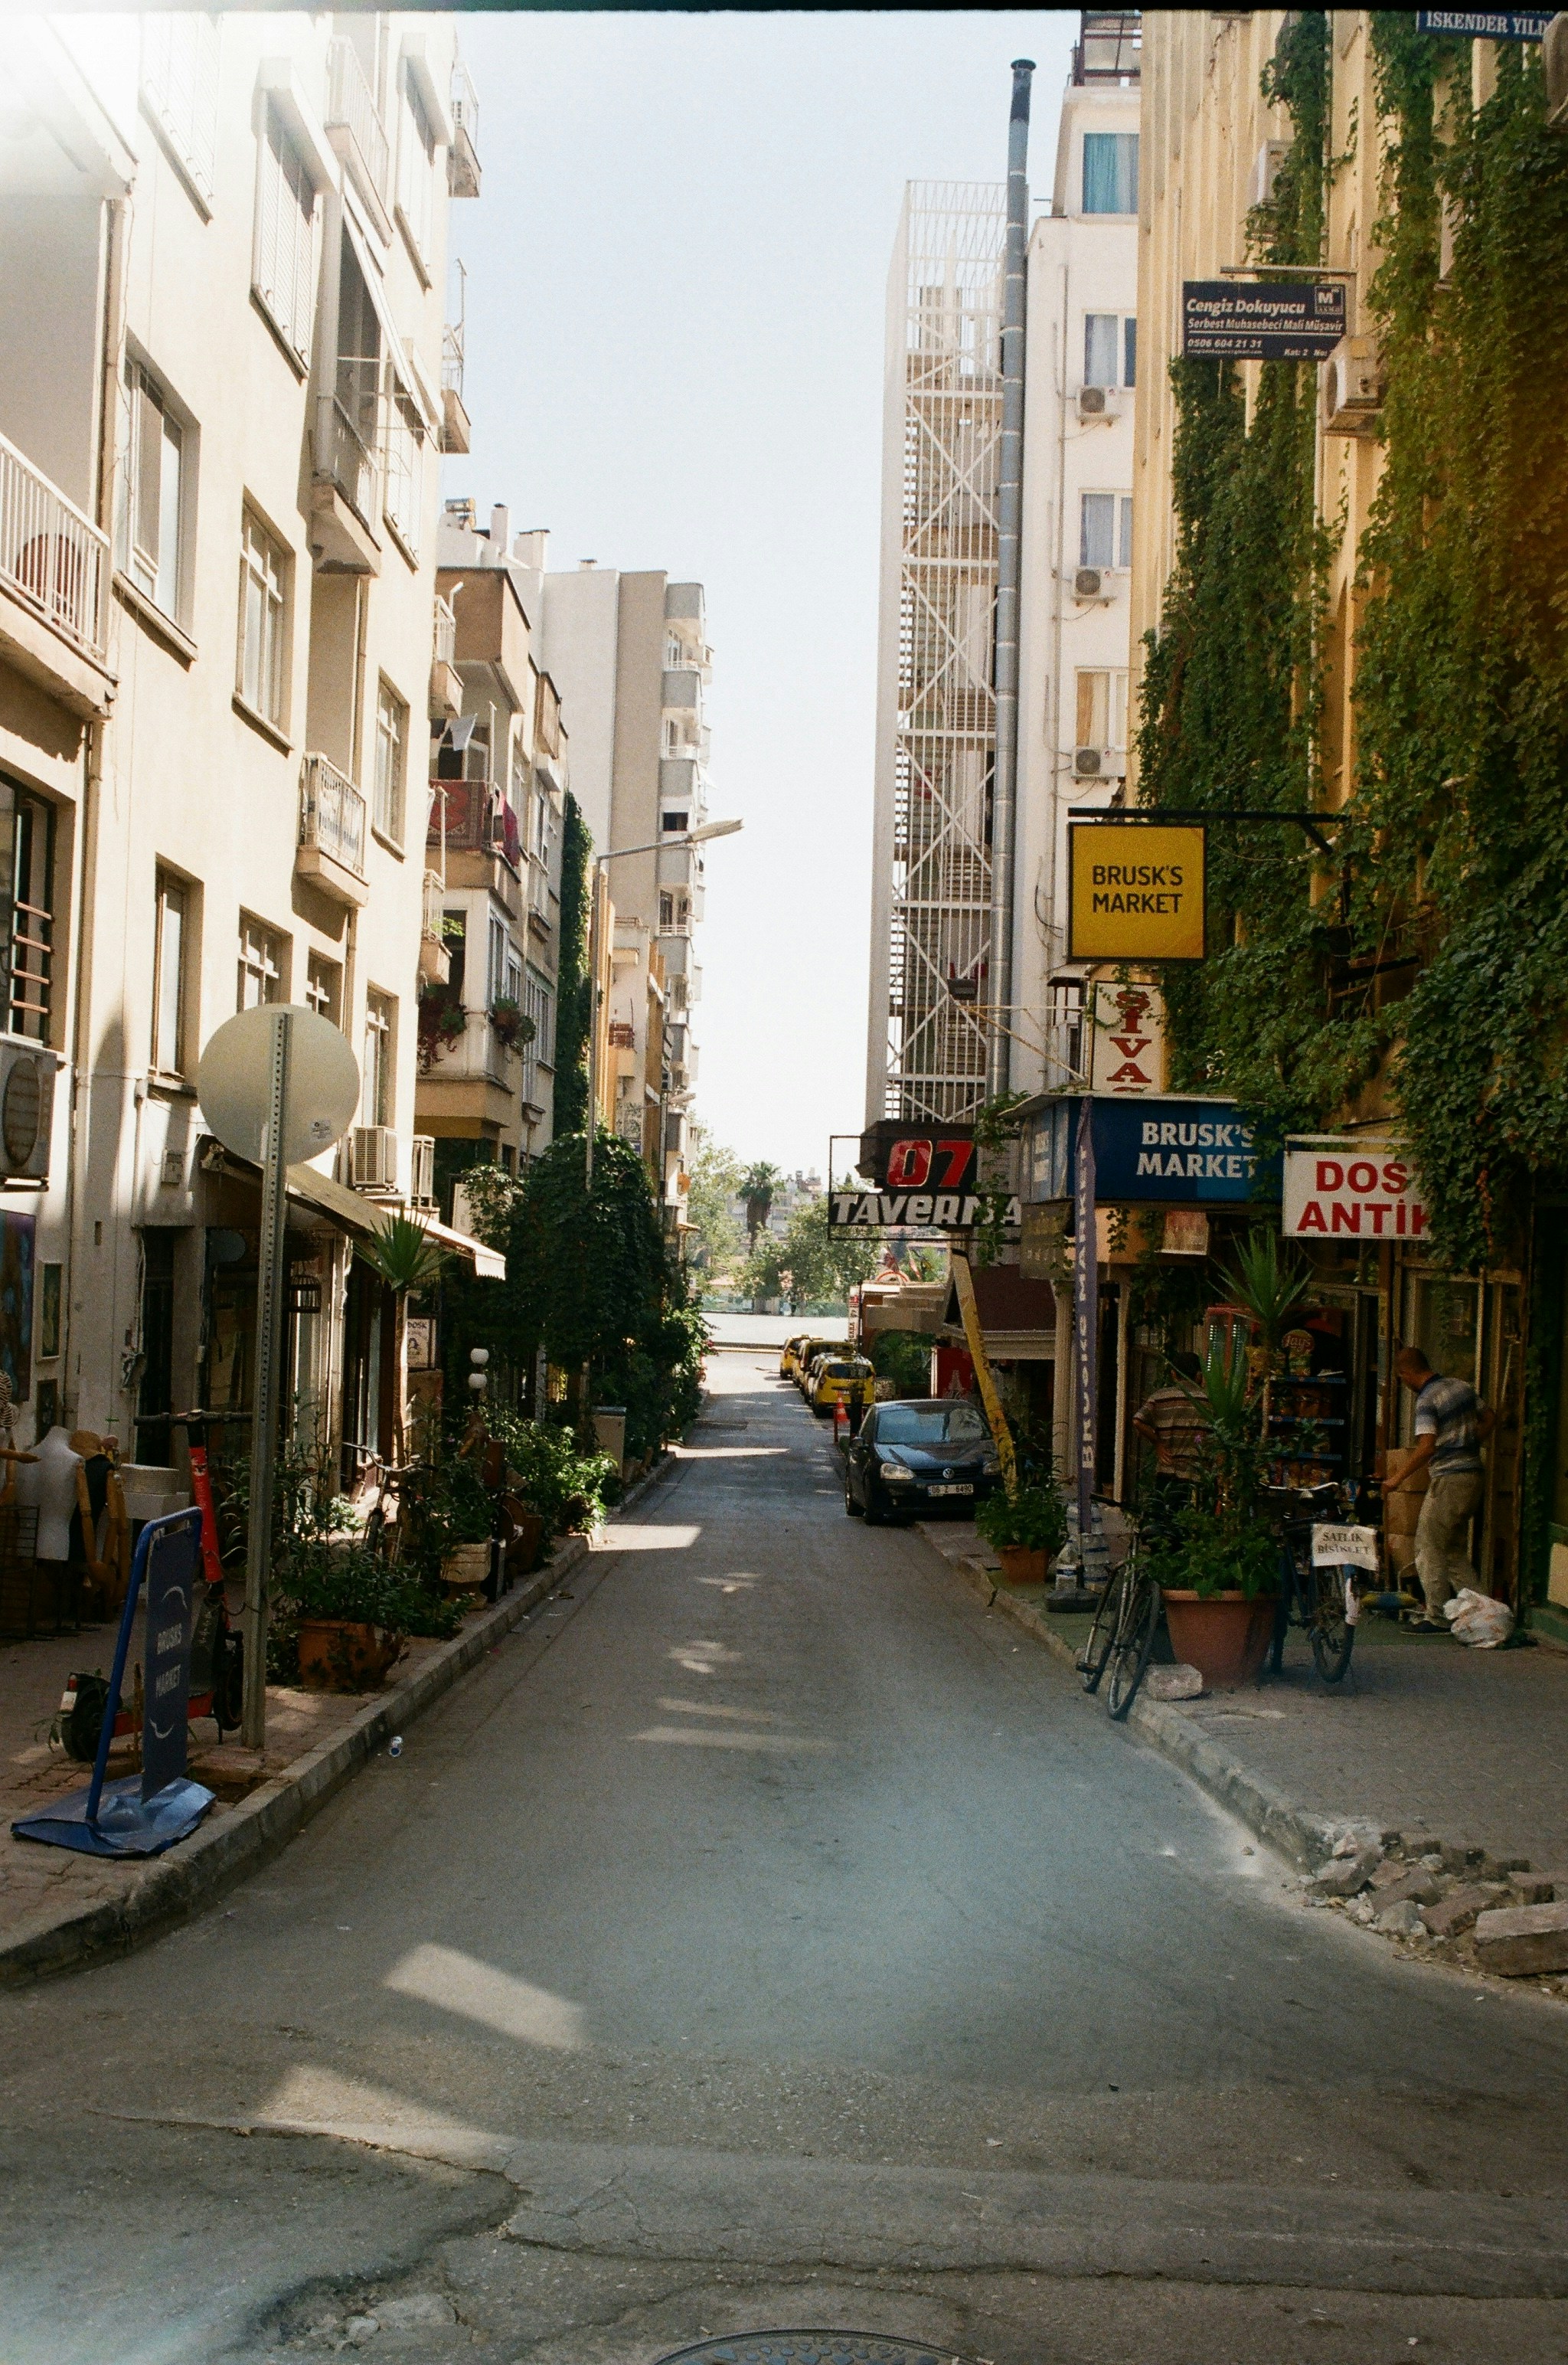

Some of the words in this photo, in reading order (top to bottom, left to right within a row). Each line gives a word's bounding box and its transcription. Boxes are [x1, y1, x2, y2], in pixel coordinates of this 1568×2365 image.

[1187, 298, 1233, 316] Cengiz
[1236, 299, 1305, 317] Dokuyucu
[1187, 318, 1225, 329] Serbest
[1226, 318, 1282, 330] Muhasebeci
[1305, 319, 1343, 332] Müşavir
[1235, 339, 1247, 348] 21
[1250, 339, 1263, 348] 31
[1092, 865, 1183, 886] BRUSK'S
[1093, 893, 1183, 914] MARKET
[1142, 1121, 1256, 1148] BRUSK'S
[887, 1140, 975, 1187] 07
[1136, 1153, 1258, 1178] MARKET
[1316, 1160, 1419, 1194] DOS
